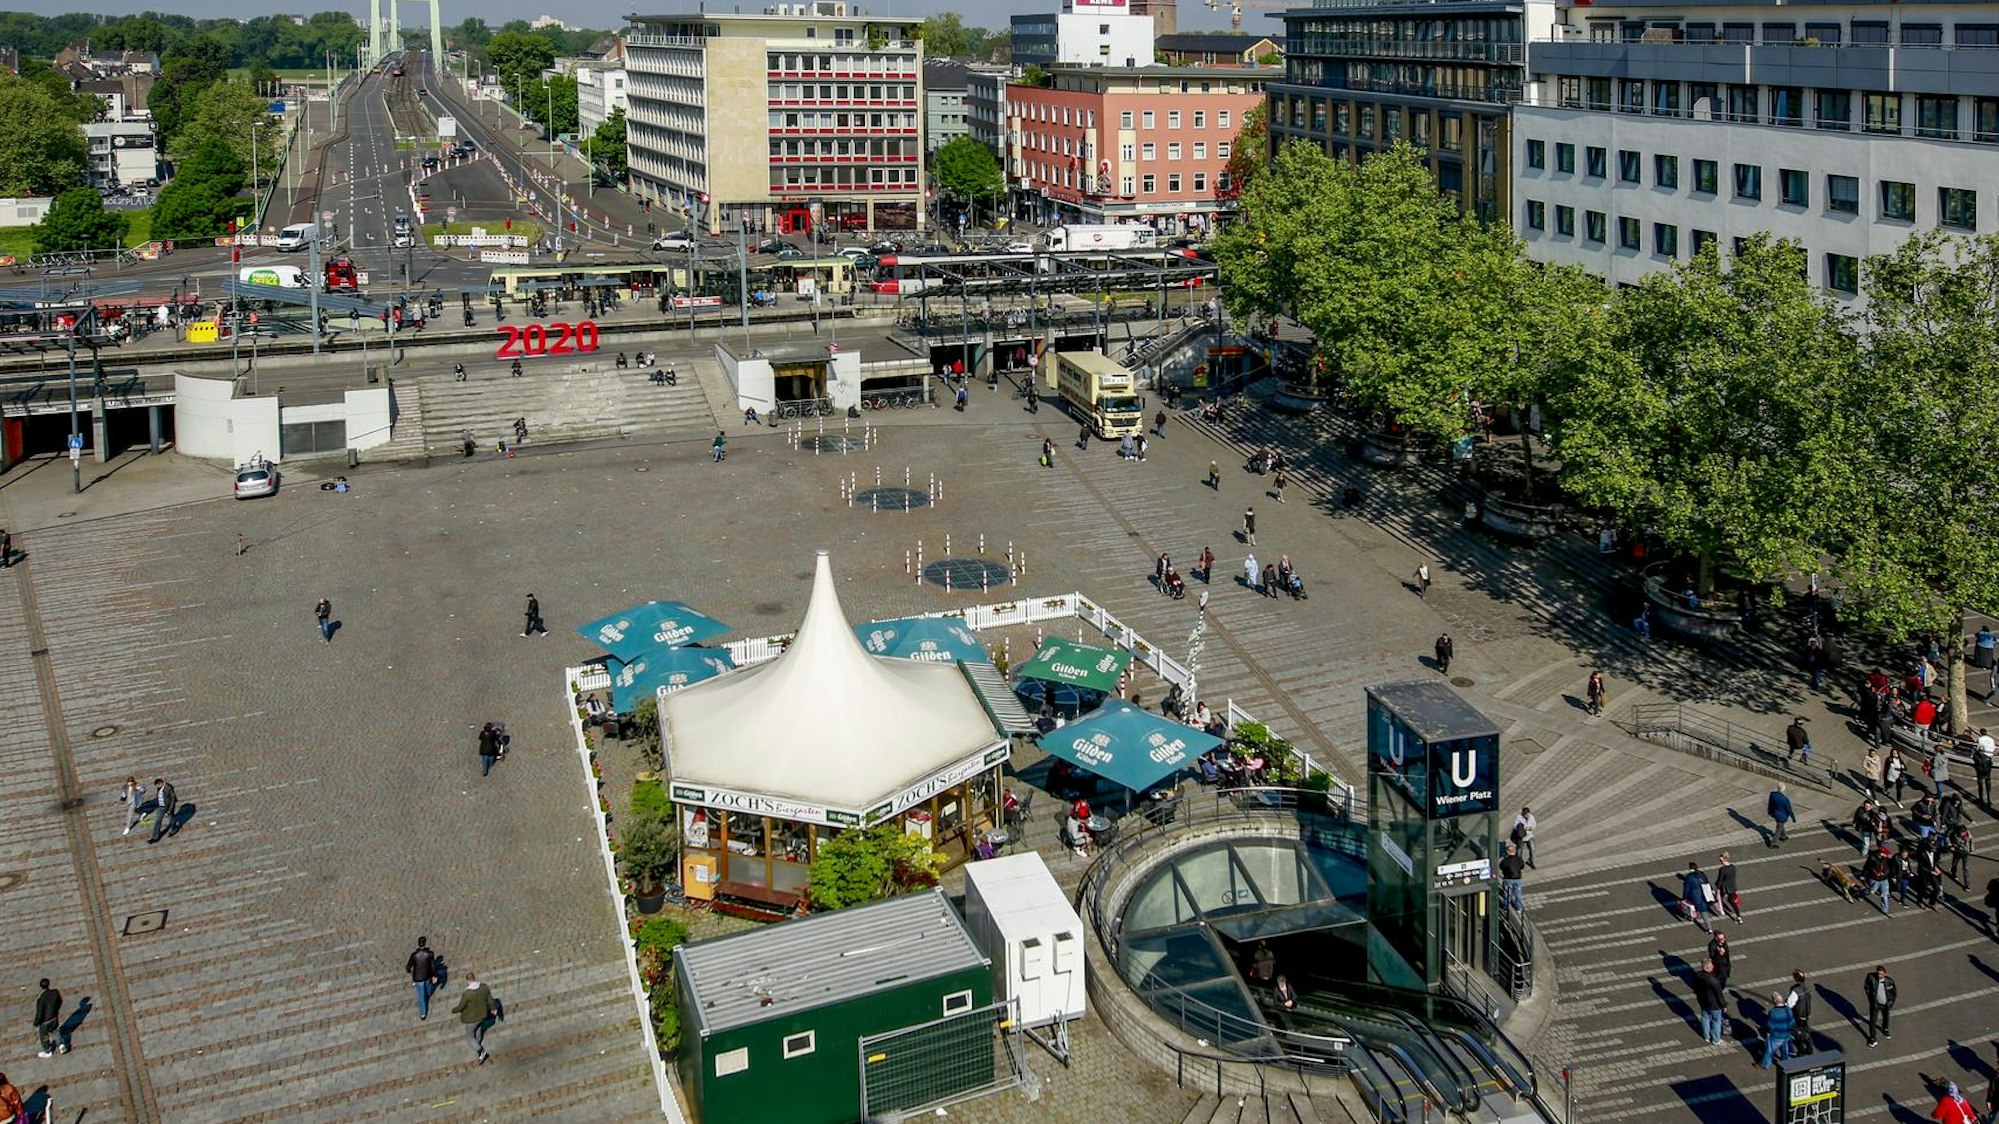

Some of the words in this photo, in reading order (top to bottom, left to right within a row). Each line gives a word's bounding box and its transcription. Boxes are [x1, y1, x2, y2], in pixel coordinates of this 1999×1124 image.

[496, 320, 599, 359] 2020
[653, 625, 694, 643] Gilden
[910, 651, 952, 661] Gilden
[1051, 662, 1089, 677] Gilden
[1072, 738, 1113, 763] Gilden
[1149, 739, 1186, 763] Gilden
[1389, 725, 1404, 766] U
[1452, 749, 1476, 788] U
[898, 774, 948, 809] ZOCH'S
[1435, 794, 1468, 805] Wiener
[1469, 791, 1492, 800] Platz
[710, 792, 774, 812] ZOCH'S
[775, 804, 823, 817] Biergarten
